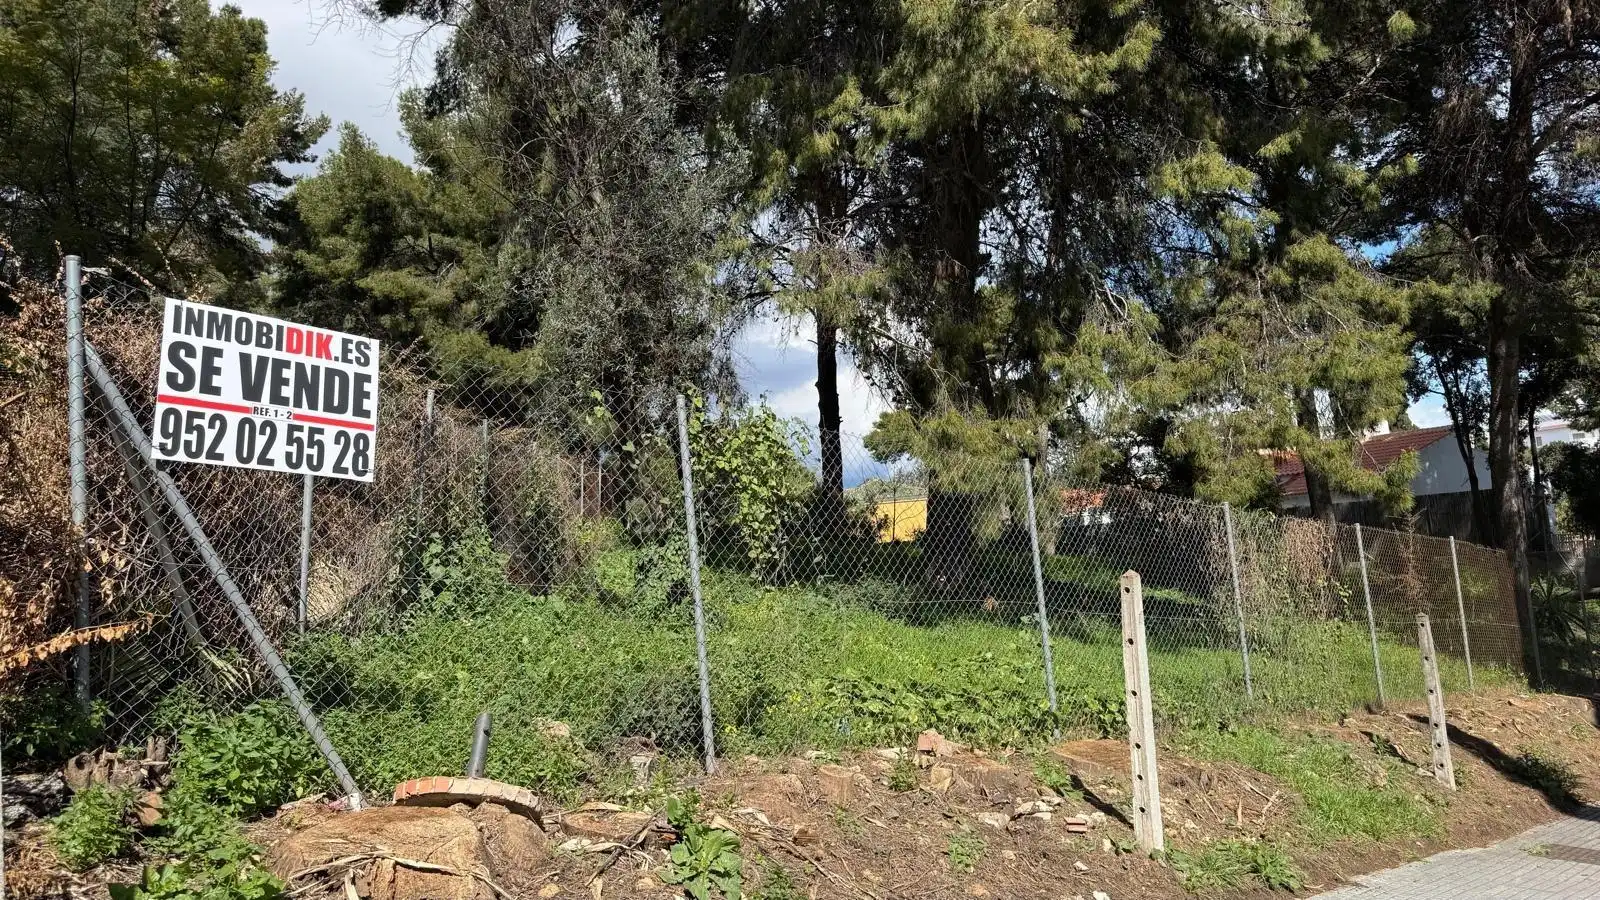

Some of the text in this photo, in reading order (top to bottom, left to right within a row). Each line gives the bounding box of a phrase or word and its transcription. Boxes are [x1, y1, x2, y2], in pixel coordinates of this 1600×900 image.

[172, 304, 371, 367] INMOBIDIK.ES
[166, 340, 372, 419] SE VENDE
[158, 407, 370, 477] 952 02 55 28
[253, 406, 271, 417] REF.
[286, 410, 292, 420] 2
